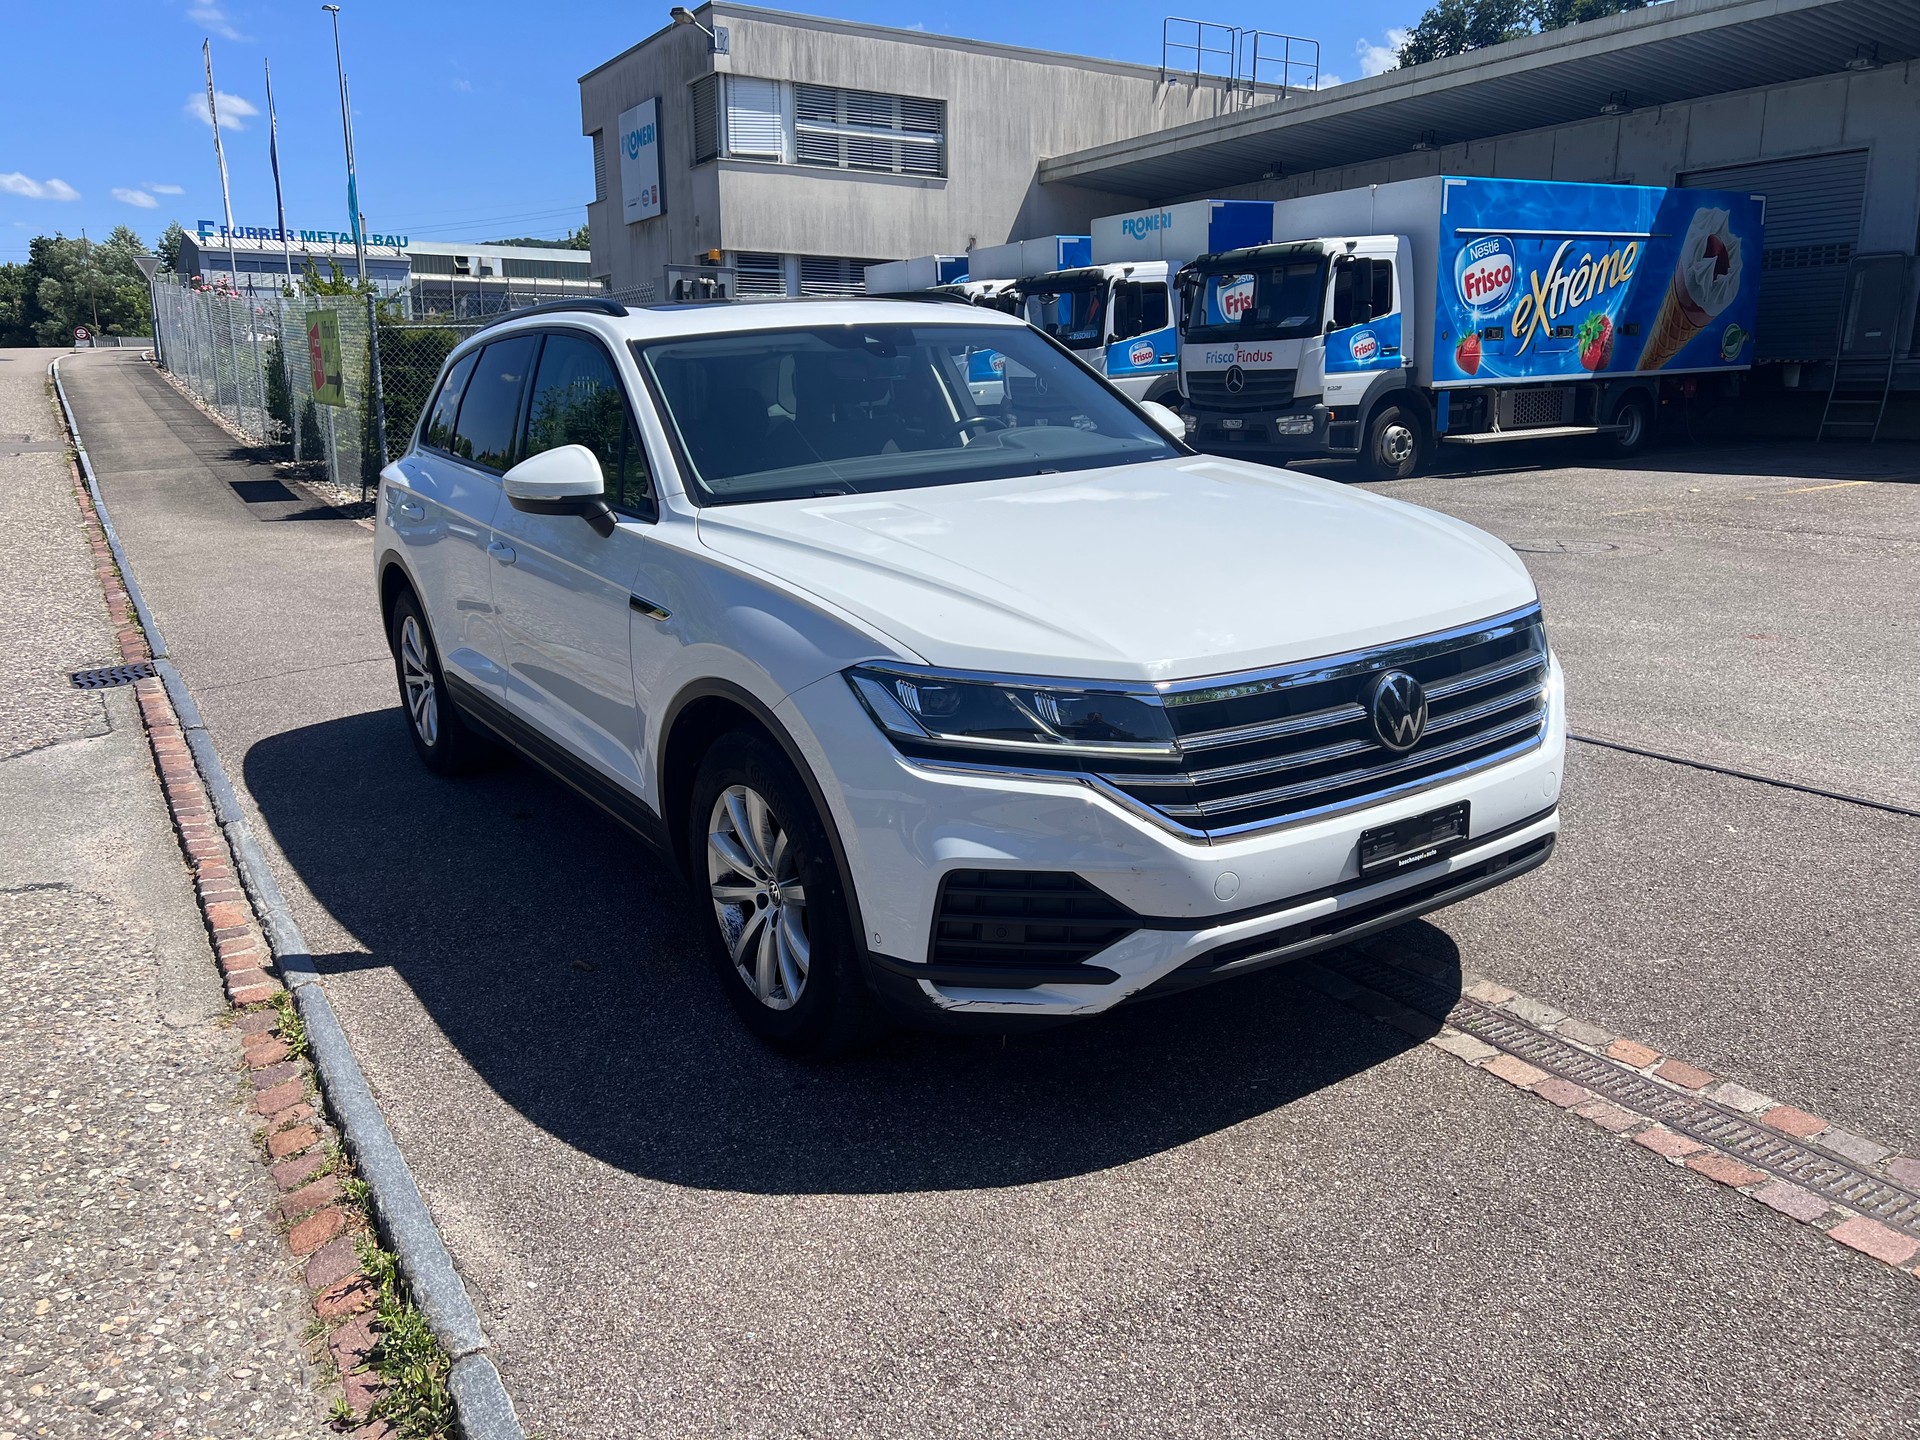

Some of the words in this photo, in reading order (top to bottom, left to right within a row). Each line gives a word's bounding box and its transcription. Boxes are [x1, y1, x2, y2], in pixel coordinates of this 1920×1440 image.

[1122, 212, 1172, 240] FRONERI
[300, 230, 408, 247] METALBAU
[1470, 238, 1500, 261] Nestlé
[1465, 265, 1511, 300] Frisco
[1132, 351, 1153, 363] Frisco
[1206, 351, 1235, 364] Frisco
[1236, 349, 1273, 363] Findus
[1354, 341, 1375, 357] Frisco
